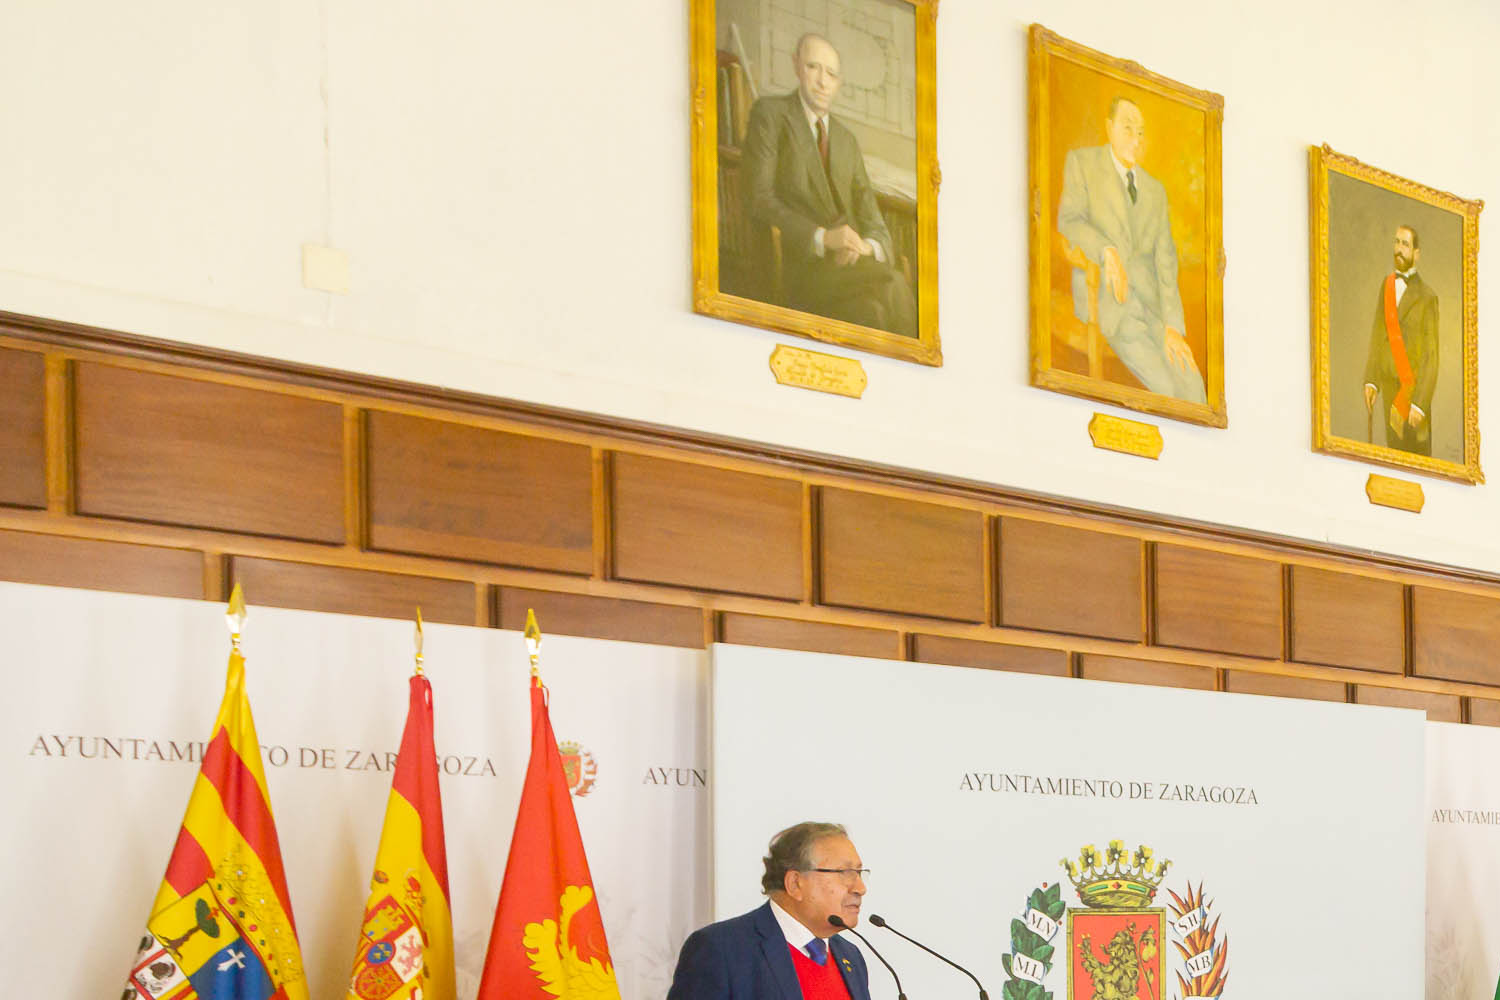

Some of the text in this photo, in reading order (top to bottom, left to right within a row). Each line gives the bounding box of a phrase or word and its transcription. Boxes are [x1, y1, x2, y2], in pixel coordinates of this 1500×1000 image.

[28, 735, 498, 777] AYUNTAMIO DE ZAROZA
[959, 773, 1259, 805] AYUNTAMIENTO DE ZARAGOZA
